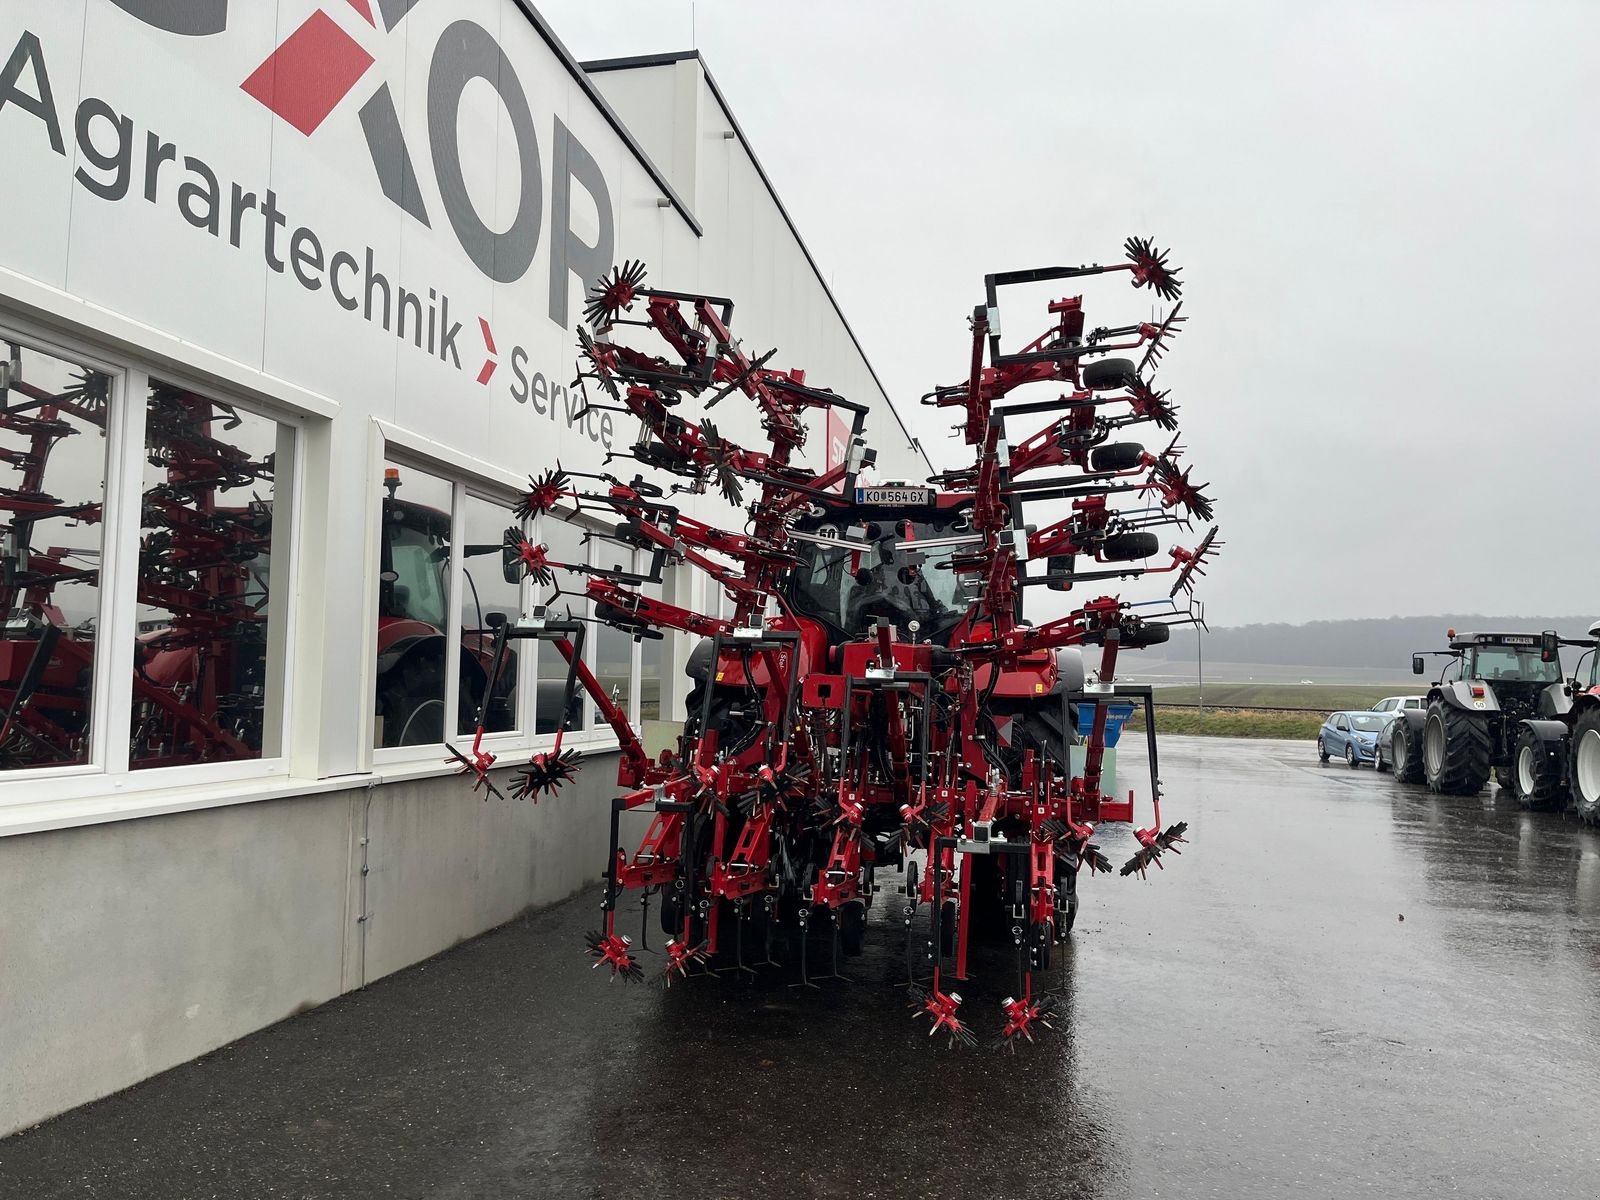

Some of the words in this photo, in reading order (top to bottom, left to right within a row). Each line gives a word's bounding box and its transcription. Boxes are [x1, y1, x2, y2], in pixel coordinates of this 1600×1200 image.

[0, 29, 463, 370] Agrartechnik
[510, 345, 613, 450] Service
[866, 491, 880, 502] KO
[887, 491, 908, 502] 564
[910, 491, 924, 503] GX
